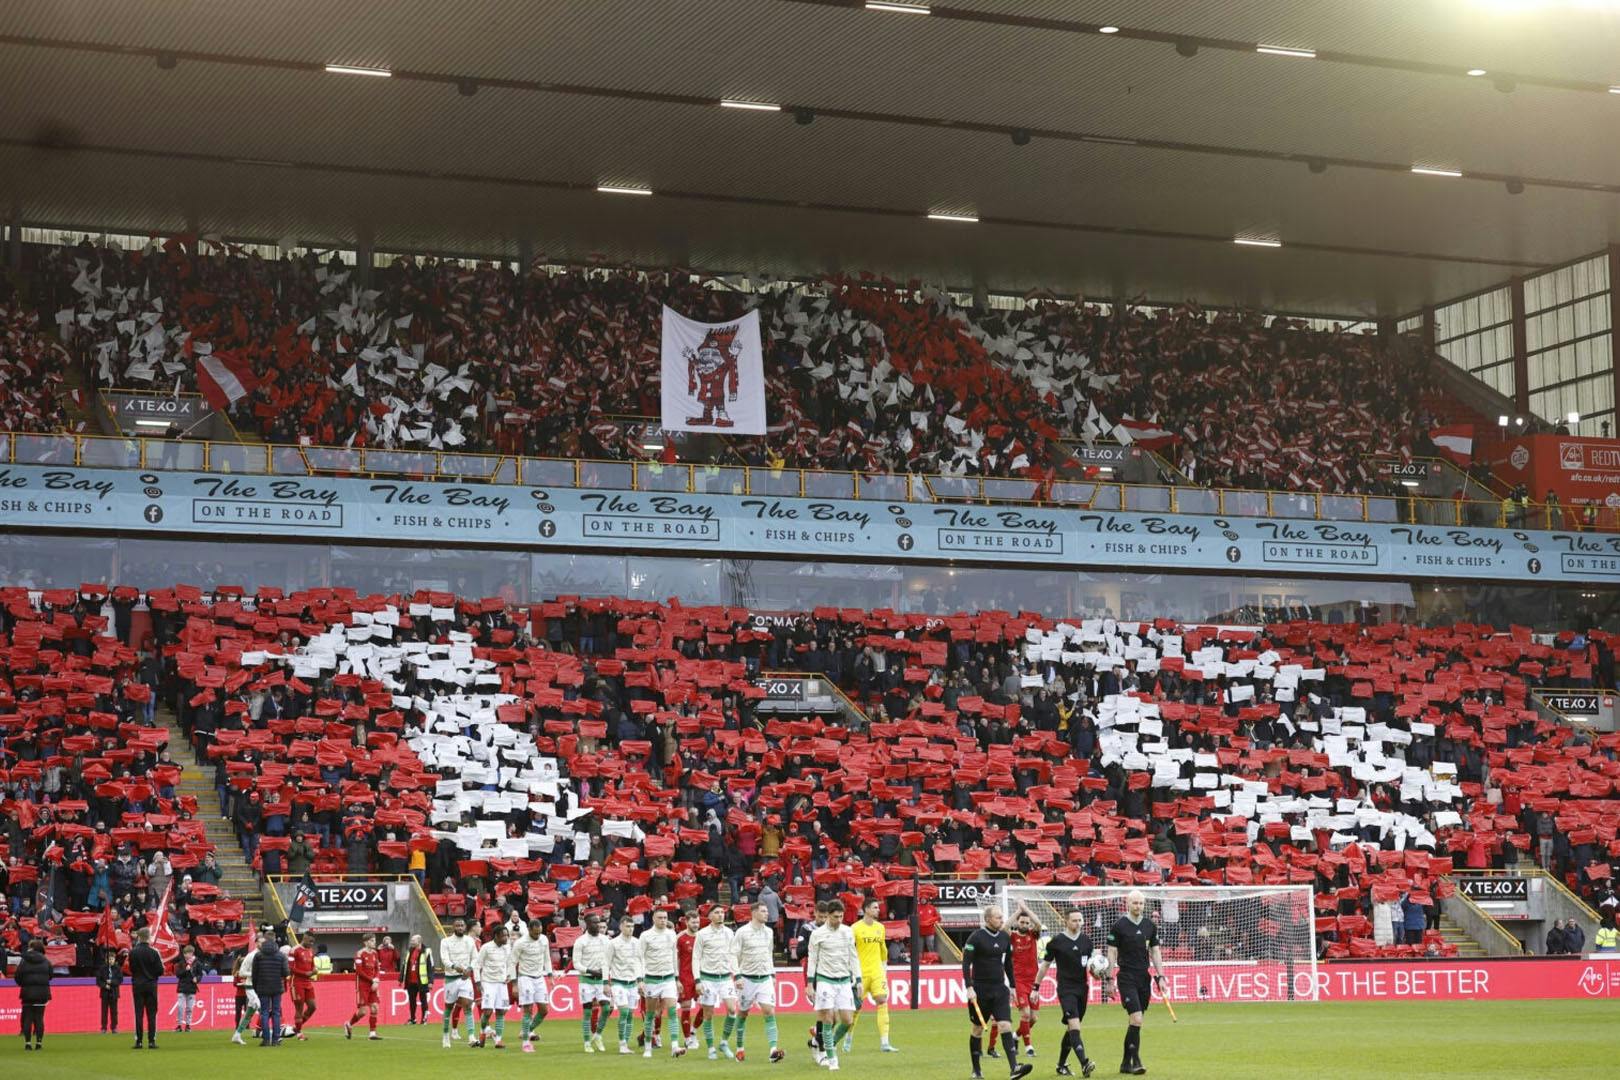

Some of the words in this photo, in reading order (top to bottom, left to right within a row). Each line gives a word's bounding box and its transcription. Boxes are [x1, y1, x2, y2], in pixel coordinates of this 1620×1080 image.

[138, 399, 177, 412] TEXO
[1082, 448, 1113, 460] TEXO
[0, 469, 27, 489] he
[42, 472, 114, 499] Bay
[193, 477, 257, 498] The
[269, 480, 338, 504] Bay
[1, 500, 22, 511] SH
[28, 501, 38, 512] &
[44, 501, 92, 513] CHIPS
[370, 484, 432, 506] The
[442, 487, 510, 515] Bay
[201, 505, 226, 517] ON
[235, 507, 272, 519] THE
[281, 509, 332, 521] ROAD
[580, 493, 640, 514] The
[649, 496, 715, 522] Bay
[741, 500, 799, 520] The
[807, 503, 871, 529] Bay
[393, 515, 428, 527] FISH
[433, 517, 443, 527] &
[448, 517, 492, 529] CHIPS
[590, 521, 613, 532] ON
[623, 522, 654, 533] THE
[663, 523, 710, 535] ROAD
[934, 508, 989, 528] The
[997, 511, 1058, 536] Bay
[1080, 515, 1135, 533] The
[1141, 518, 1201, 542] Bay
[765, 529, 796, 541] FISH
[801, 530, 810, 541] &
[815, 531, 855, 543] CHIPS
[945, 534, 965, 545] ON
[974, 535, 1003, 546] THE
[1011, 537, 1054, 549] ROAD
[1256, 522, 1309, 541] The
[1314, 525, 1372, 548] Bay
[1390, 528, 1442, 545] The
[1447, 531, 1503, 554] Bay
[1105, 542, 1133, 553] FISH
[1138, 544, 1146, 554] &
[1150, 544, 1188, 556] CHIPS
[1552, 535, 1603, 552] The
[1269, 546, 1288, 557] ON
[1296, 548, 1323, 559] THE
[1330, 549, 1370, 561] ROAD
[1415, 554, 1442, 565] FISH
[1446, 556, 1454, 566] &
[1457, 556, 1492, 567] CHIPS
[1567, 558, 1585, 569] ON
[1590, 559, 1617, 570] THE
[1555, 698, 1586, 709] TEXO
[938, 885, 978, 899] TEXO
[1475, 881, 1512, 894] TEXO
[318, 888, 367, 903] TEXO
[1195, 972, 1270, 999] LIVES
[1278, 971, 1330, 997] FOR
[1336, 970, 1386, 996] THE
[1395, 969, 1490, 995] BETTER
